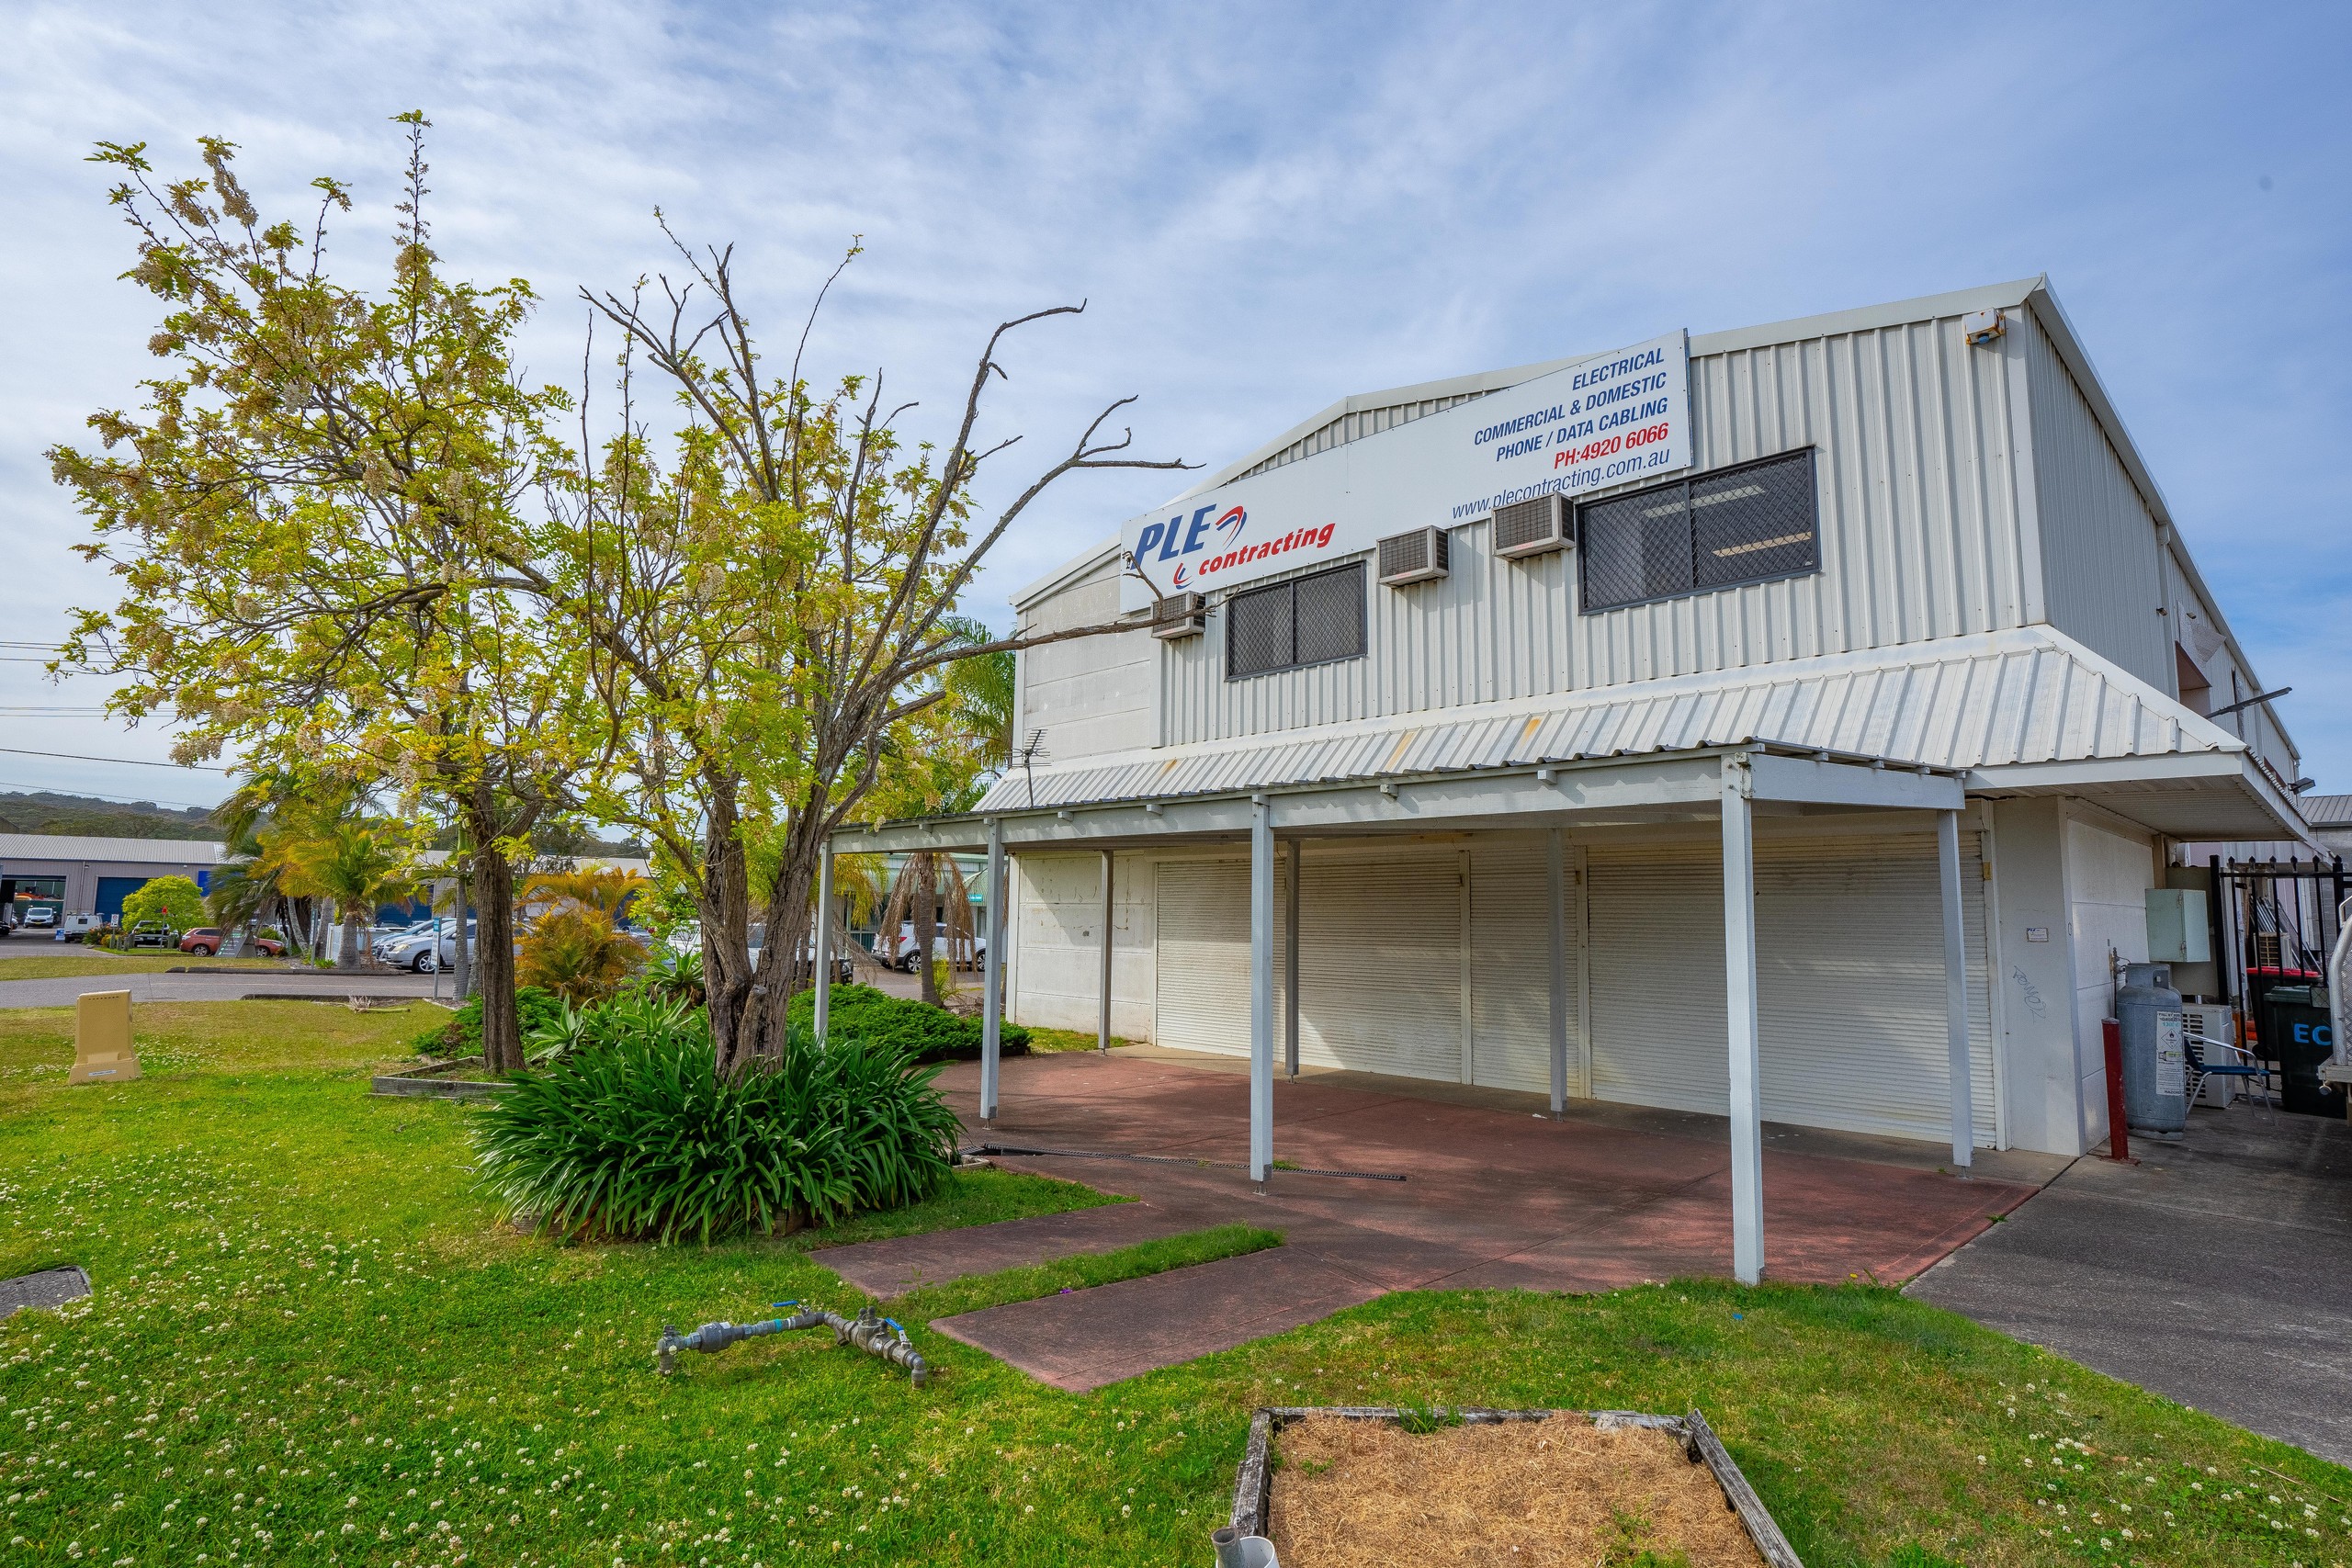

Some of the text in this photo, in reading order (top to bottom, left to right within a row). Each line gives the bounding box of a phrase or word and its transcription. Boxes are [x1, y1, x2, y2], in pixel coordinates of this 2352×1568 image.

[1572, 347, 1665, 391] ELECTRICAL
[1474, 372, 1667, 446] COMMERCIAL & DOMESTIC
[1496, 397, 1668, 462] PHONE / DATA CABLING
[1554, 422, 1668, 469] PH:4920 6066
[1453, 449, 1670, 519] www.plecontracting.com.au
[1130, 503, 1217, 570] PLE
[1198, 523, 1336, 576] contracting
